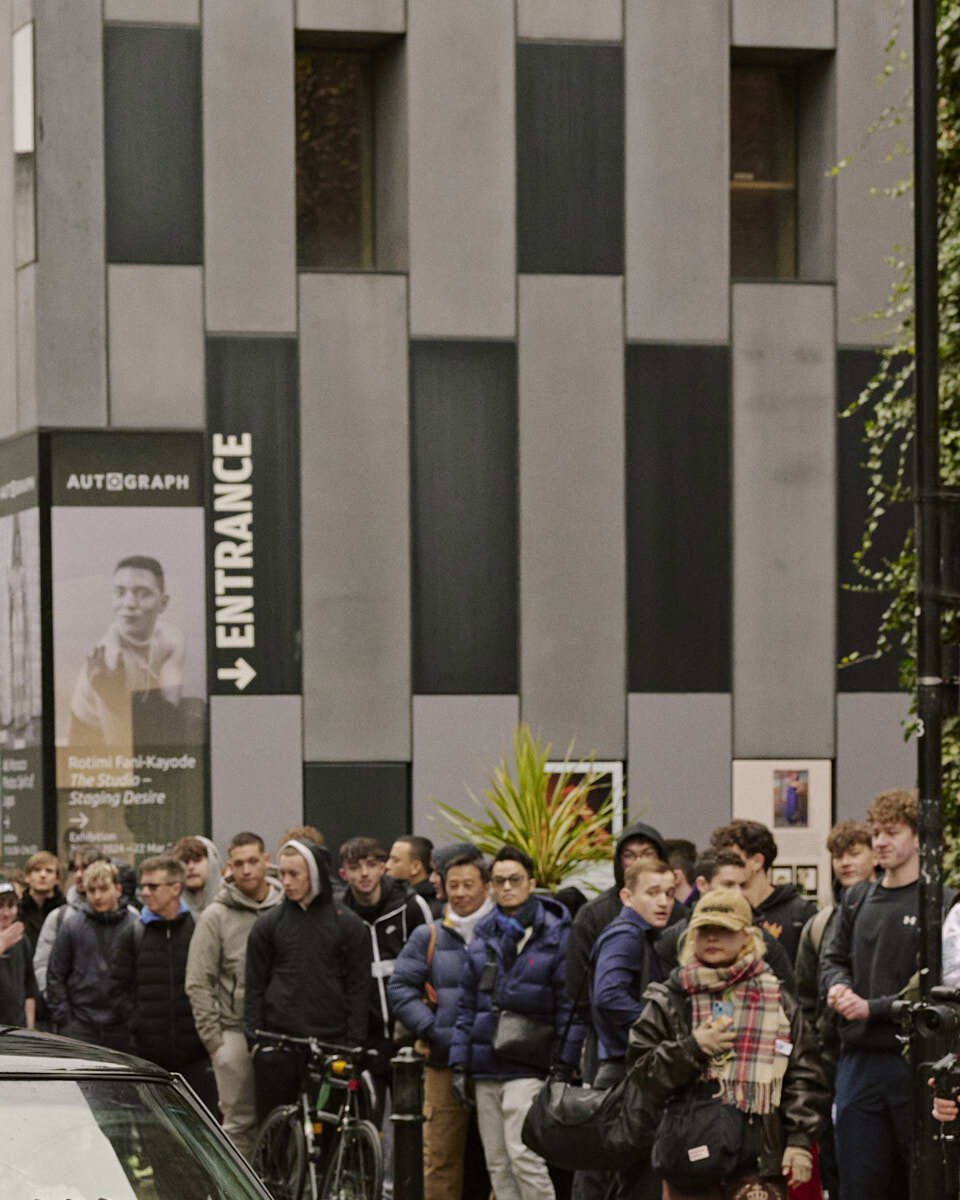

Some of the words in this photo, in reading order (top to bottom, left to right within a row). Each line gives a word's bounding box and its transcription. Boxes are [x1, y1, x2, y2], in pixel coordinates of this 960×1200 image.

[213, 432, 255, 649] ENTRANCE
[68, 755, 113, 769] Rotimi
[116, 755, 196, 771] Fani-Kayode
[70, 774, 95, 787] The
[98, 773, 140, 788] Studio
[68, 790, 121, 808] Staging
[123, 790, 166, 805] Desire
